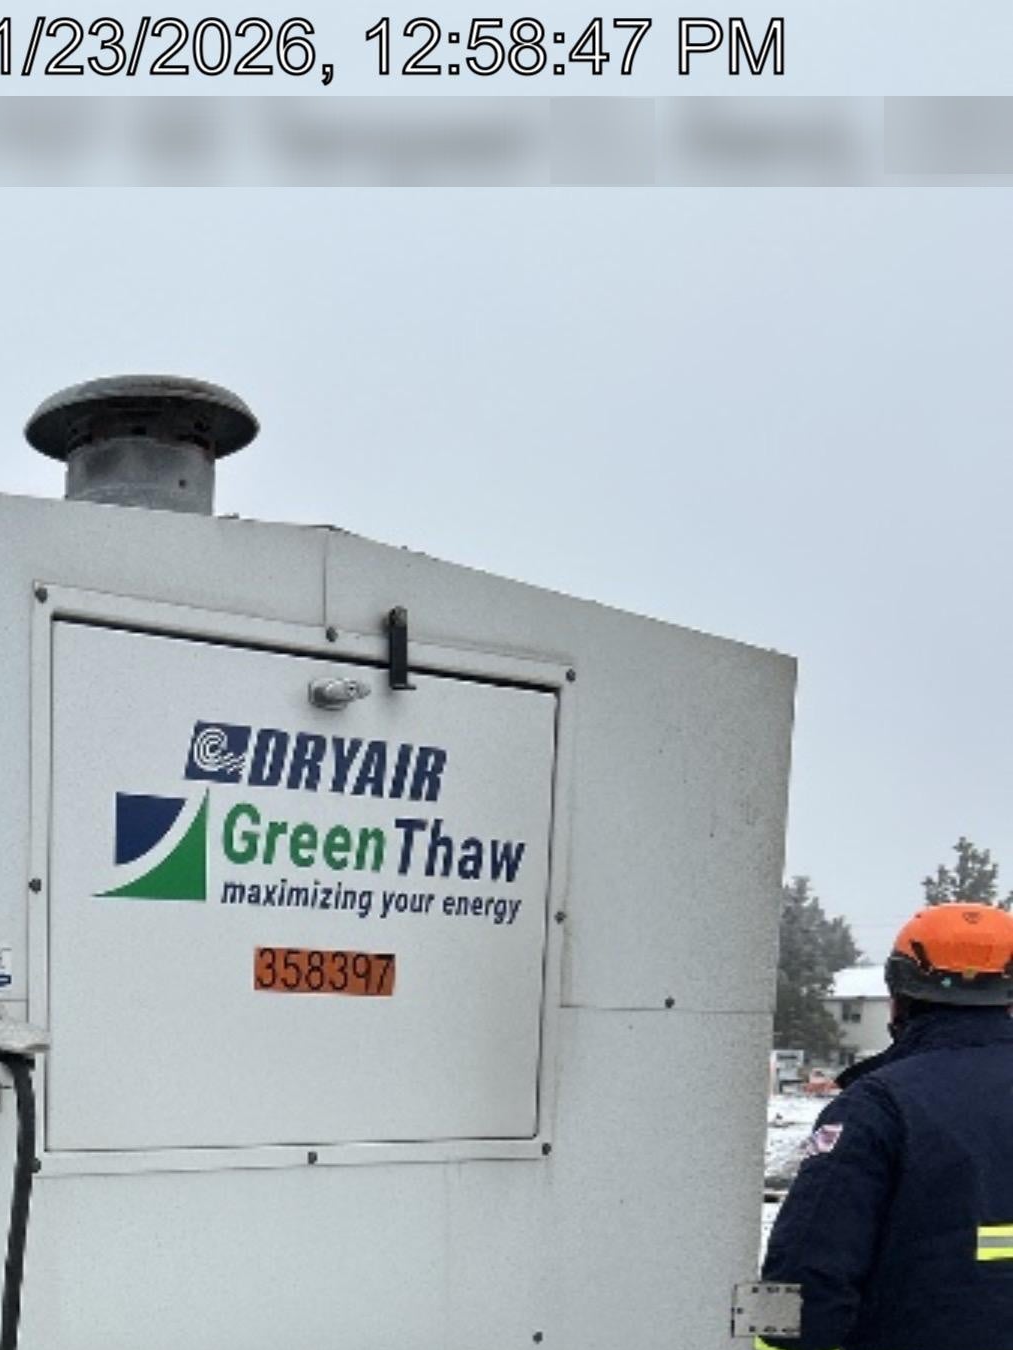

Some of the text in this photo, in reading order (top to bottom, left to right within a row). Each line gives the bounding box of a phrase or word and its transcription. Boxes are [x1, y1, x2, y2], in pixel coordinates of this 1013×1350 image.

[248, 728, 447, 803] DRYAIR
[221, 878, 523, 925] maximizing your energy
[256, 948, 391, 993] 358397
